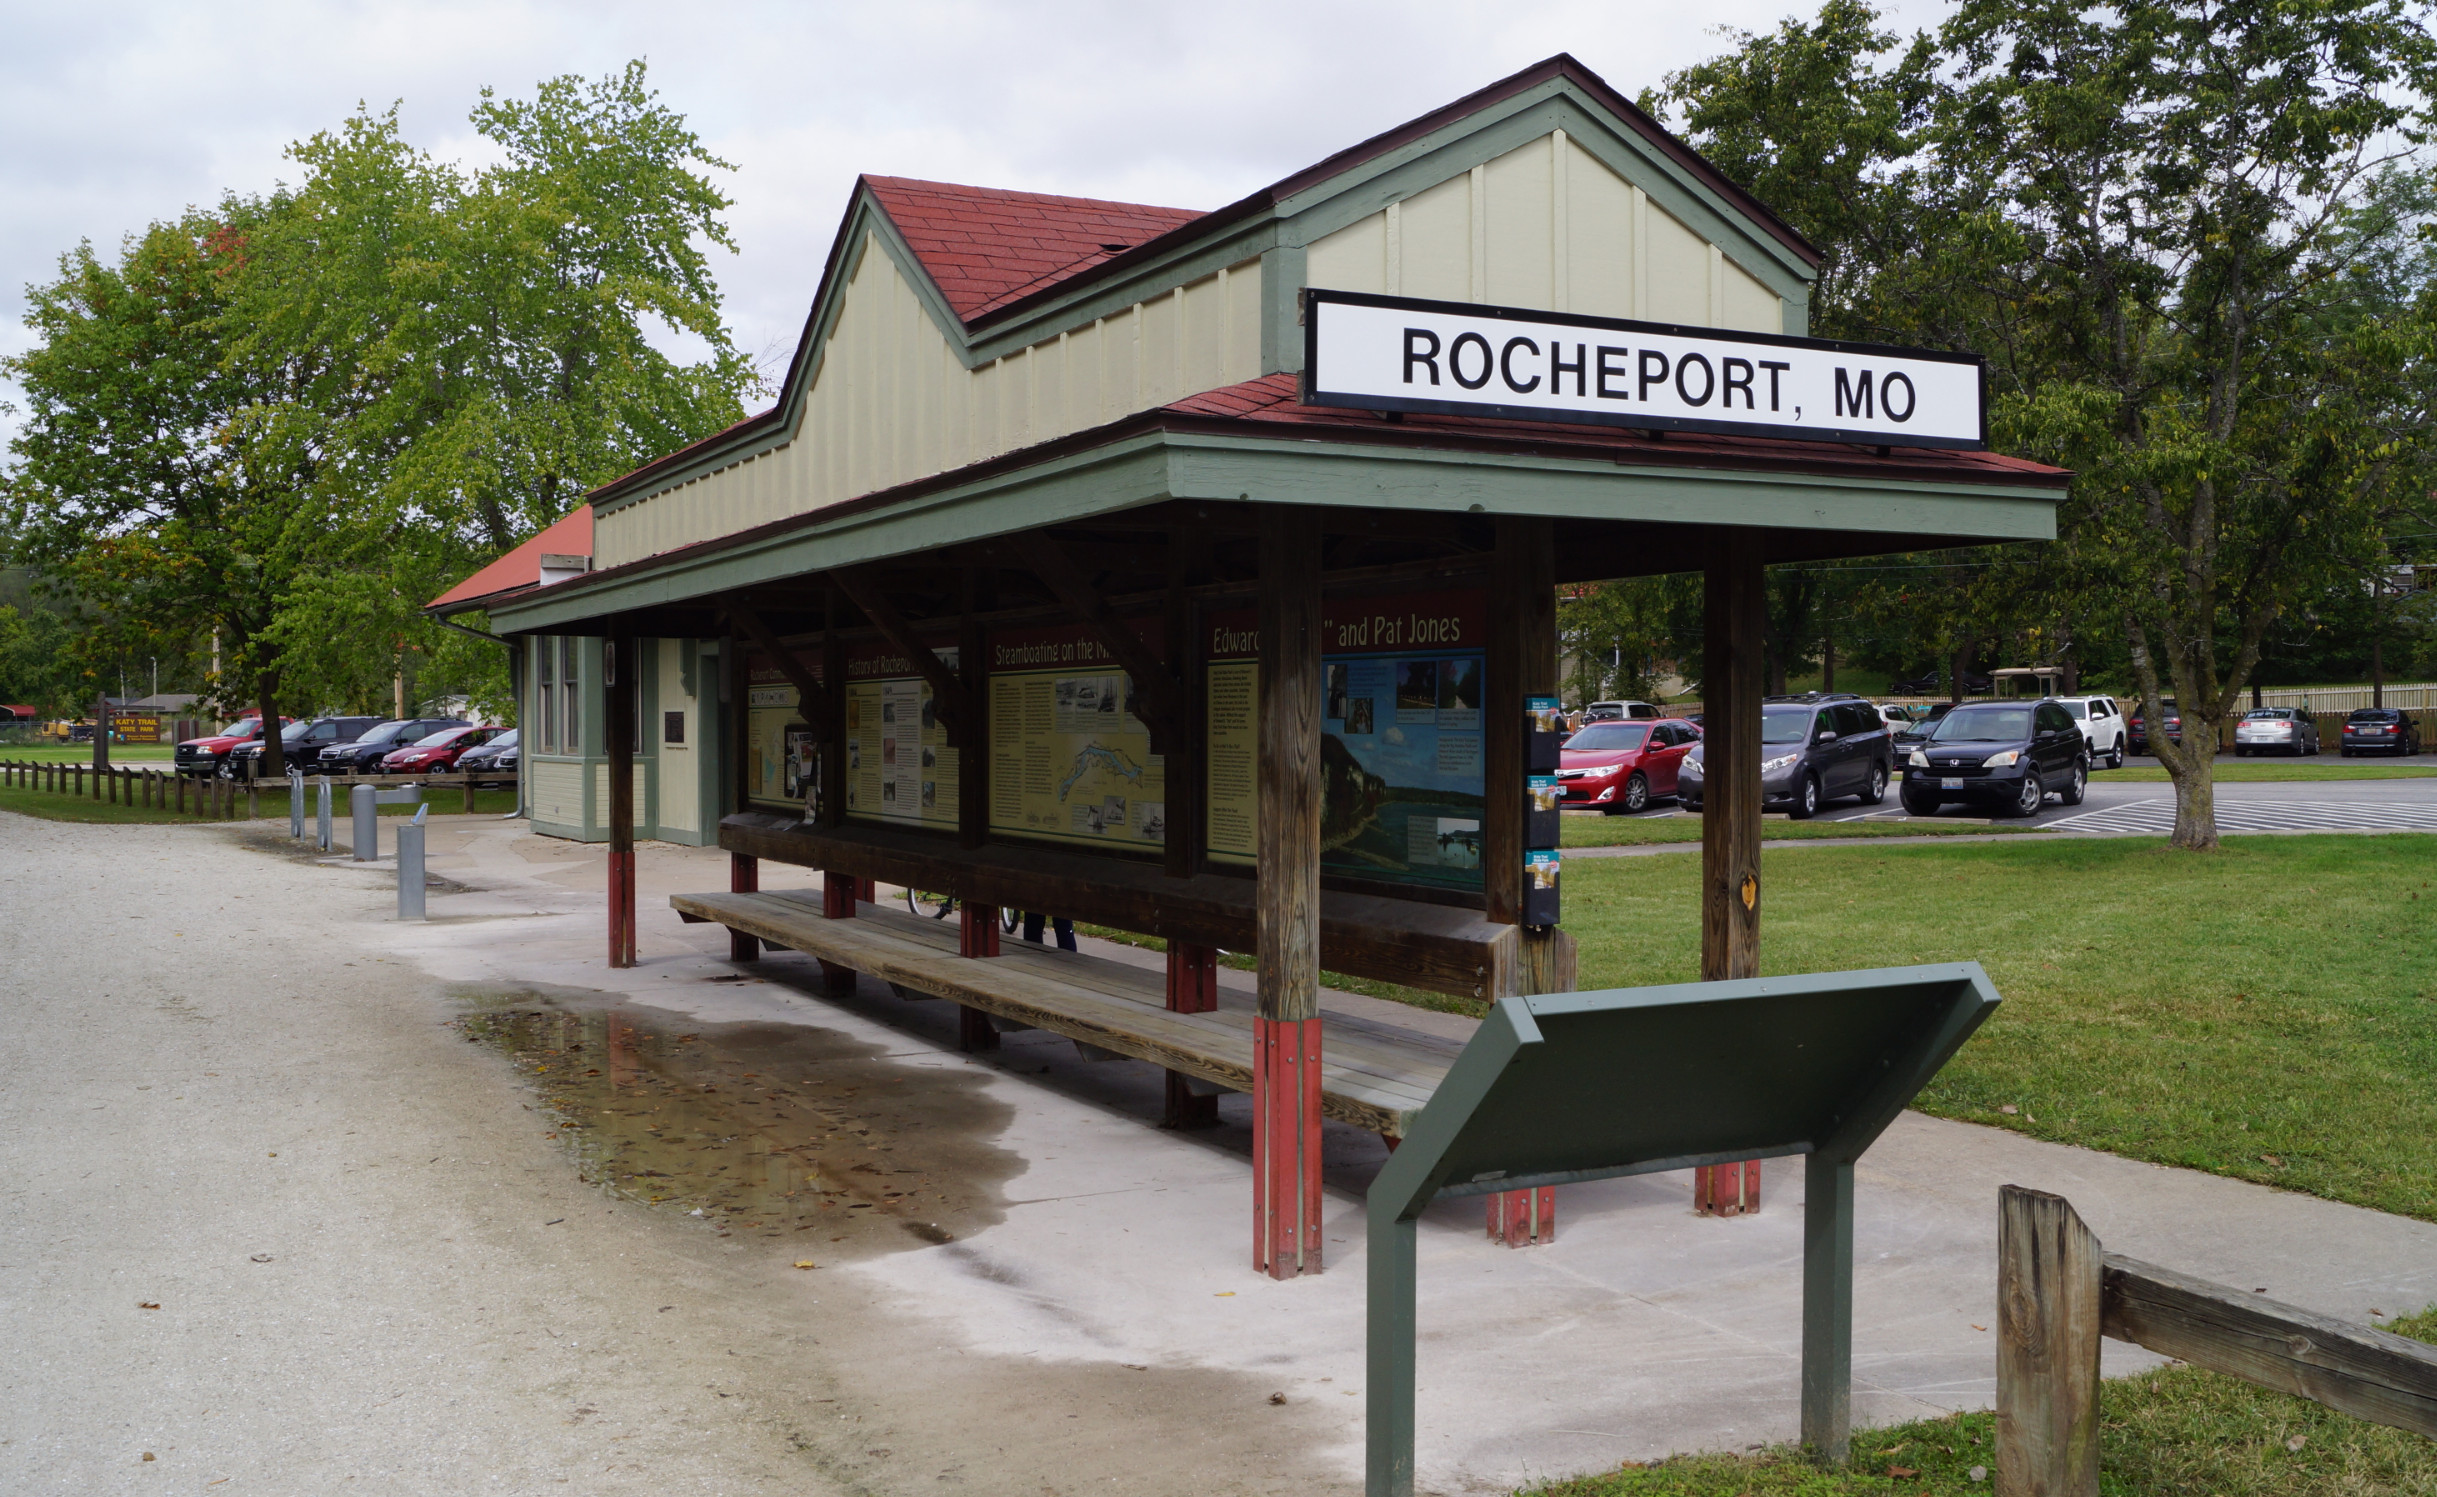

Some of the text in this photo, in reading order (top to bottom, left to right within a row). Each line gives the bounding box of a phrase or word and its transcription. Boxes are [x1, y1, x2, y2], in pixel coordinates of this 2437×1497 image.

[1402, 326, 1917, 423] ROCHEPORT, MO
[1338, 616, 1367, 647] and
[1374, 616, 1403, 644] Pat
[1408, 613, 1461, 644] Jones
[848, 658, 871, 677] History
[872, 655, 880, 674] of
[995, 640, 1060, 666] Steamboating
[1061, 642, 1075, 662] on
[1076, 636, 1094, 660] the
[137, 718, 158, 726] TRAIL
